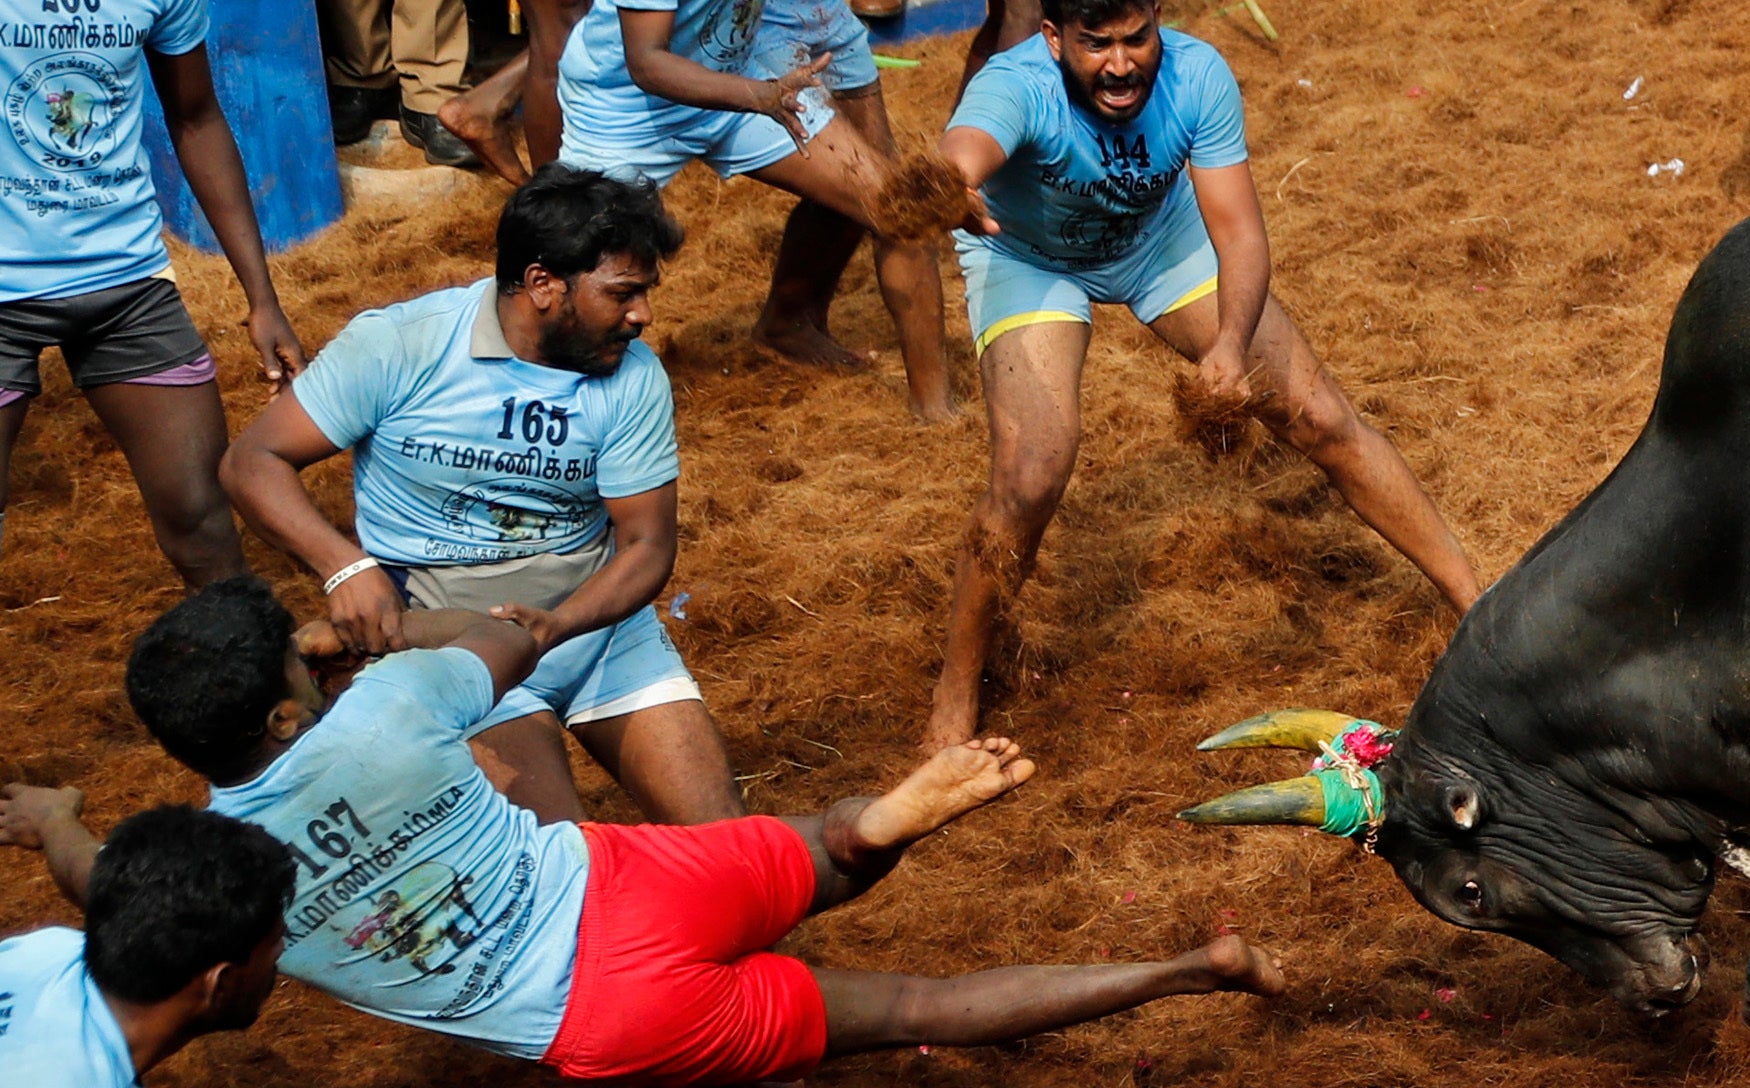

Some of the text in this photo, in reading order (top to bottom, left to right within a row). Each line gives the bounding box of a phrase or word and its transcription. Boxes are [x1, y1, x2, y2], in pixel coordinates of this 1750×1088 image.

[42, 151, 102, 168] 2019
[497, 395, 570, 447] 165
[287, 797, 372, 880] 167
